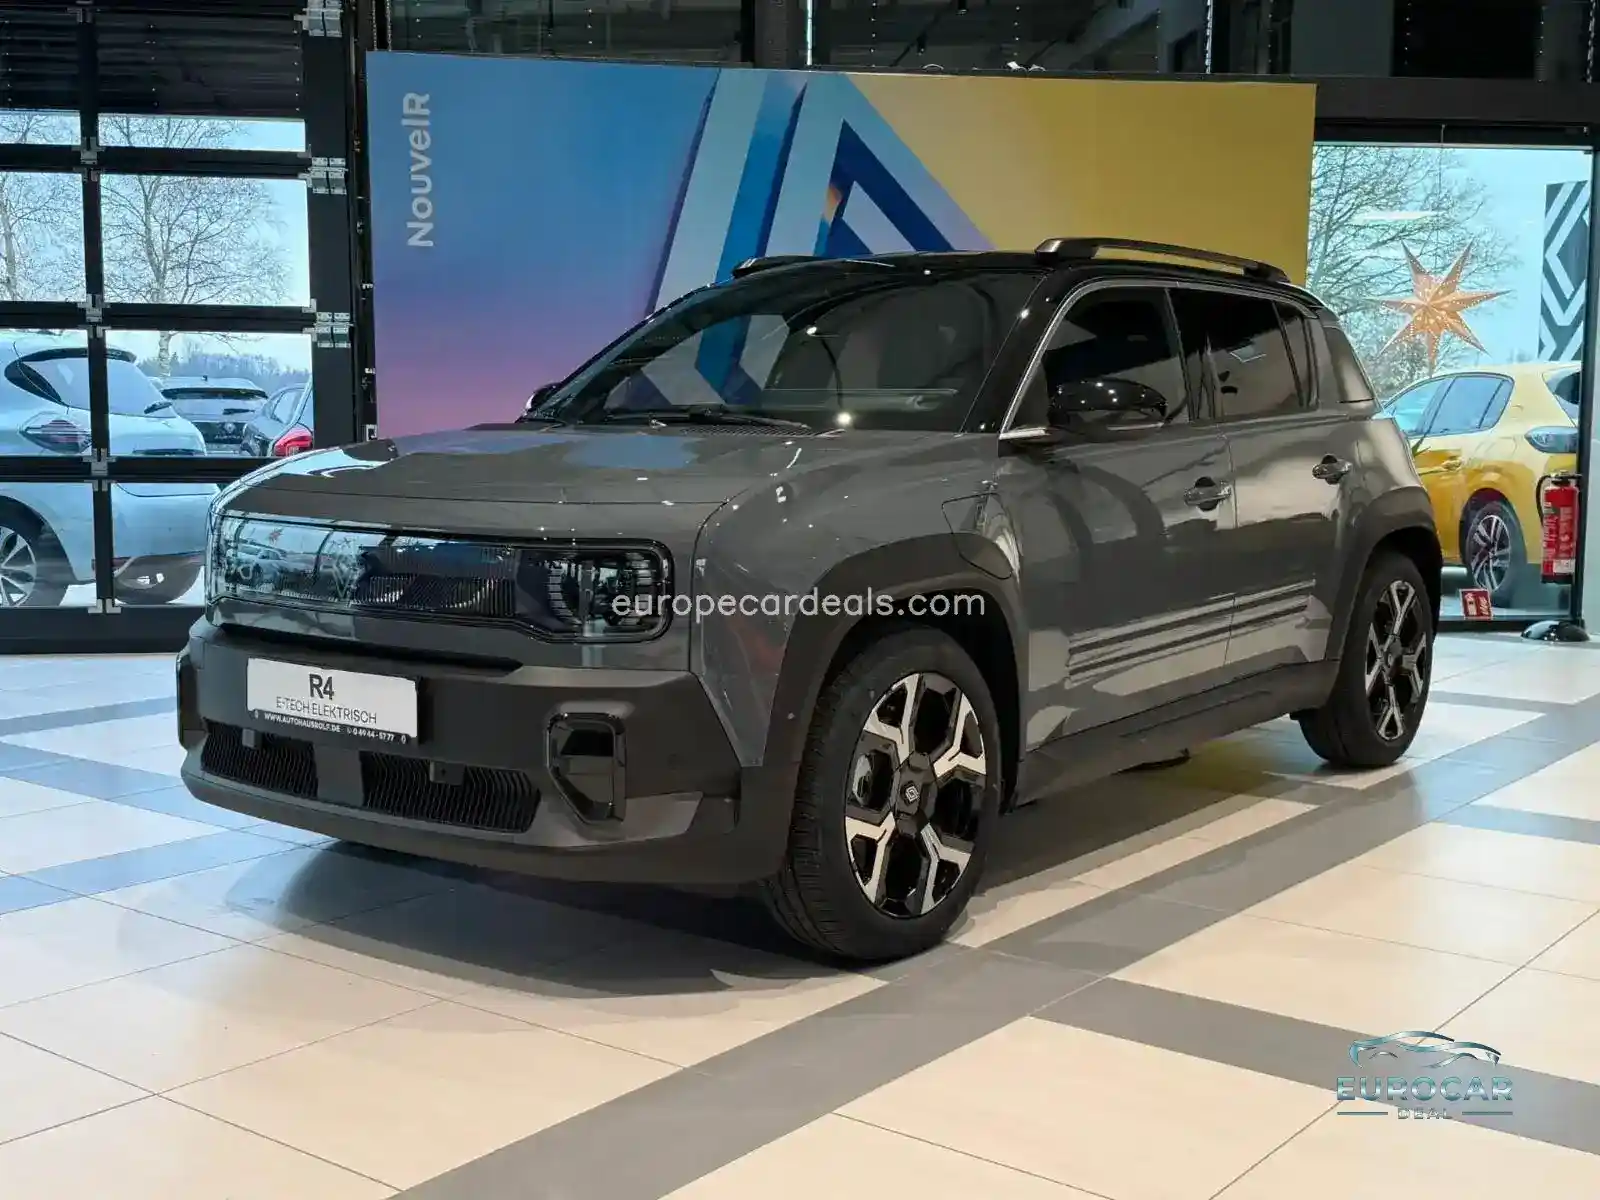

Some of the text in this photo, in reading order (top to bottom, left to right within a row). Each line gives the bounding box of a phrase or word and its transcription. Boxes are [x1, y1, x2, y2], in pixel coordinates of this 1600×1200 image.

[401, 92, 434, 247] NouvelR
[309, 673, 335, 700] R4
[276, 696, 377, 724] E-TECH ELEKTRISCH
